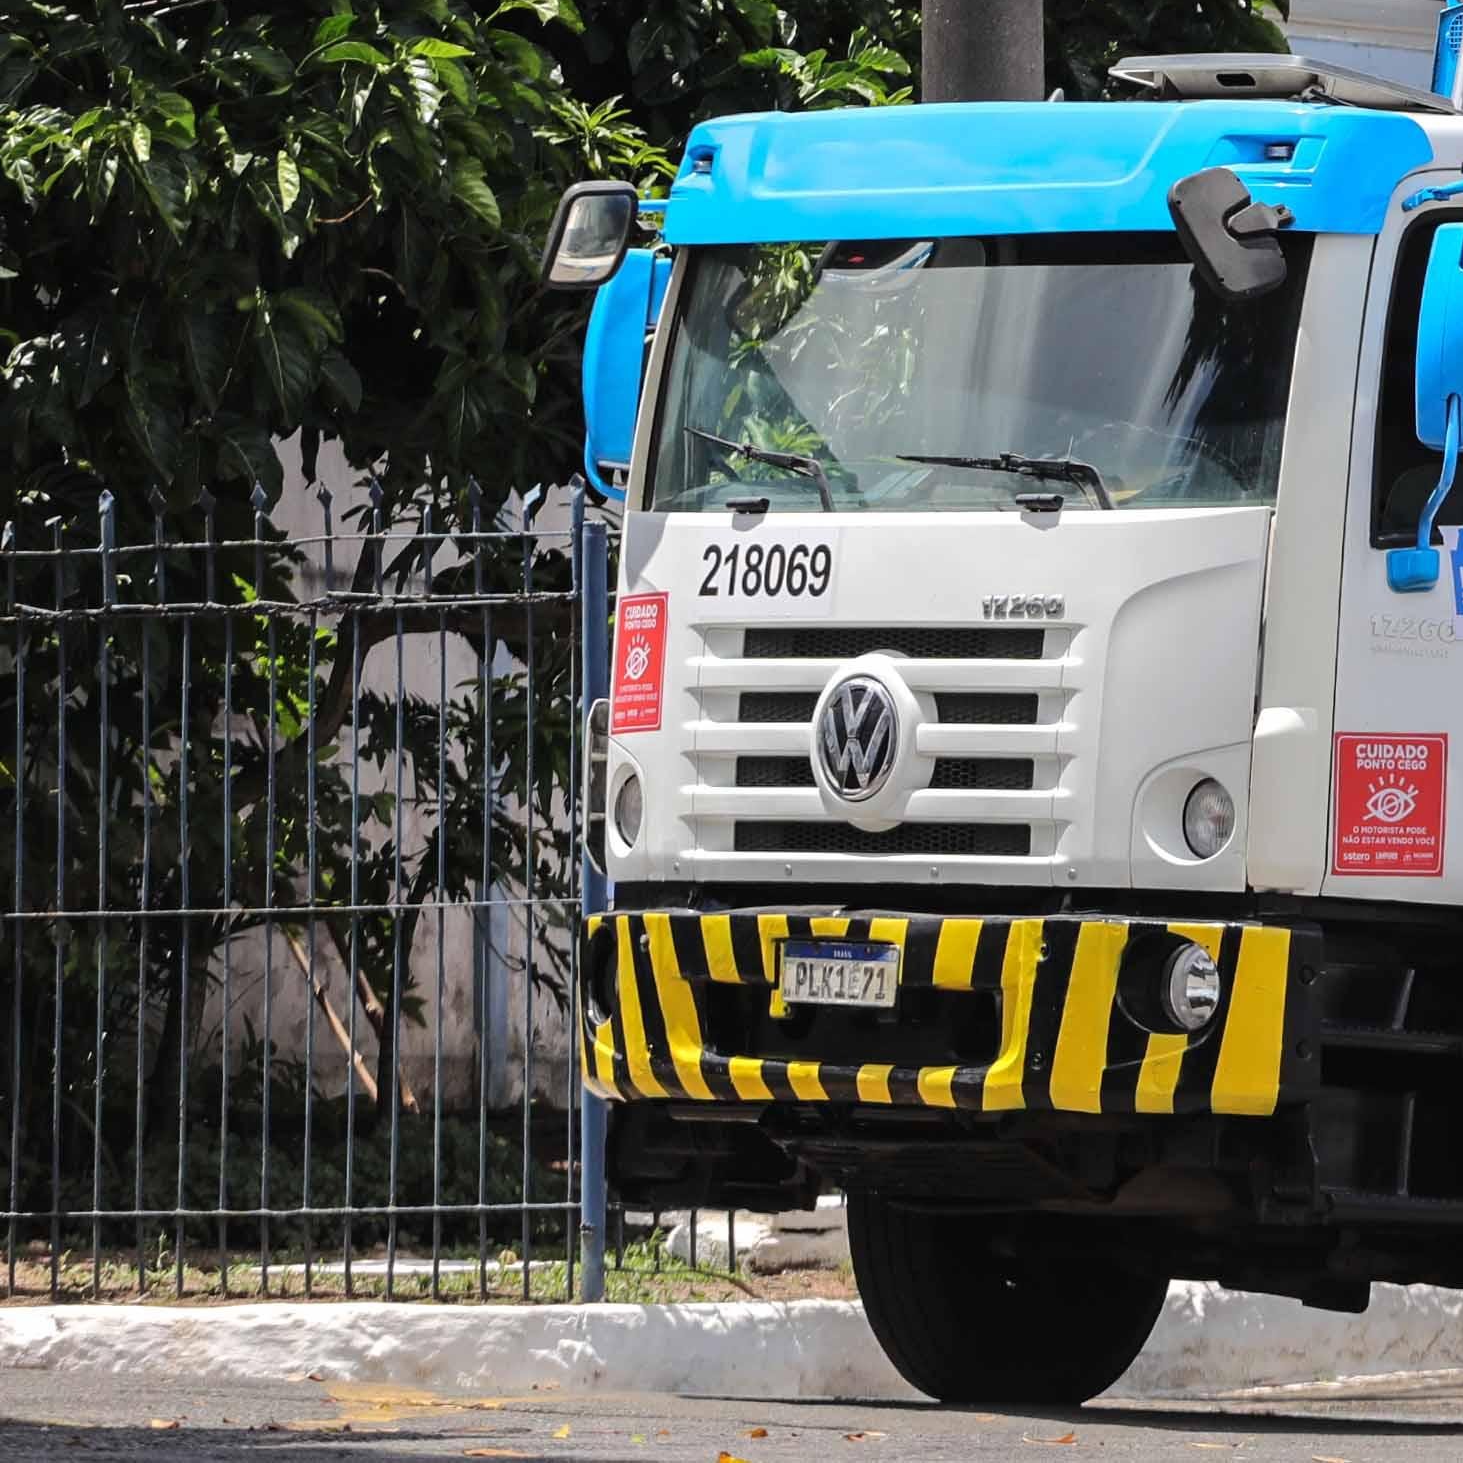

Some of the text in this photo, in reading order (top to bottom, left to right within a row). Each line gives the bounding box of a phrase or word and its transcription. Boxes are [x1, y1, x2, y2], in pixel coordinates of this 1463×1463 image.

[697, 543, 833, 598] 218069
[1355, 743, 1429, 759] CUIDADO
[1356, 759, 1427, 771] PONTO CEGO
[1352, 826, 1427, 835] O MOTORISTA PODE
[1342, 834, 1360, 844] NÃO
